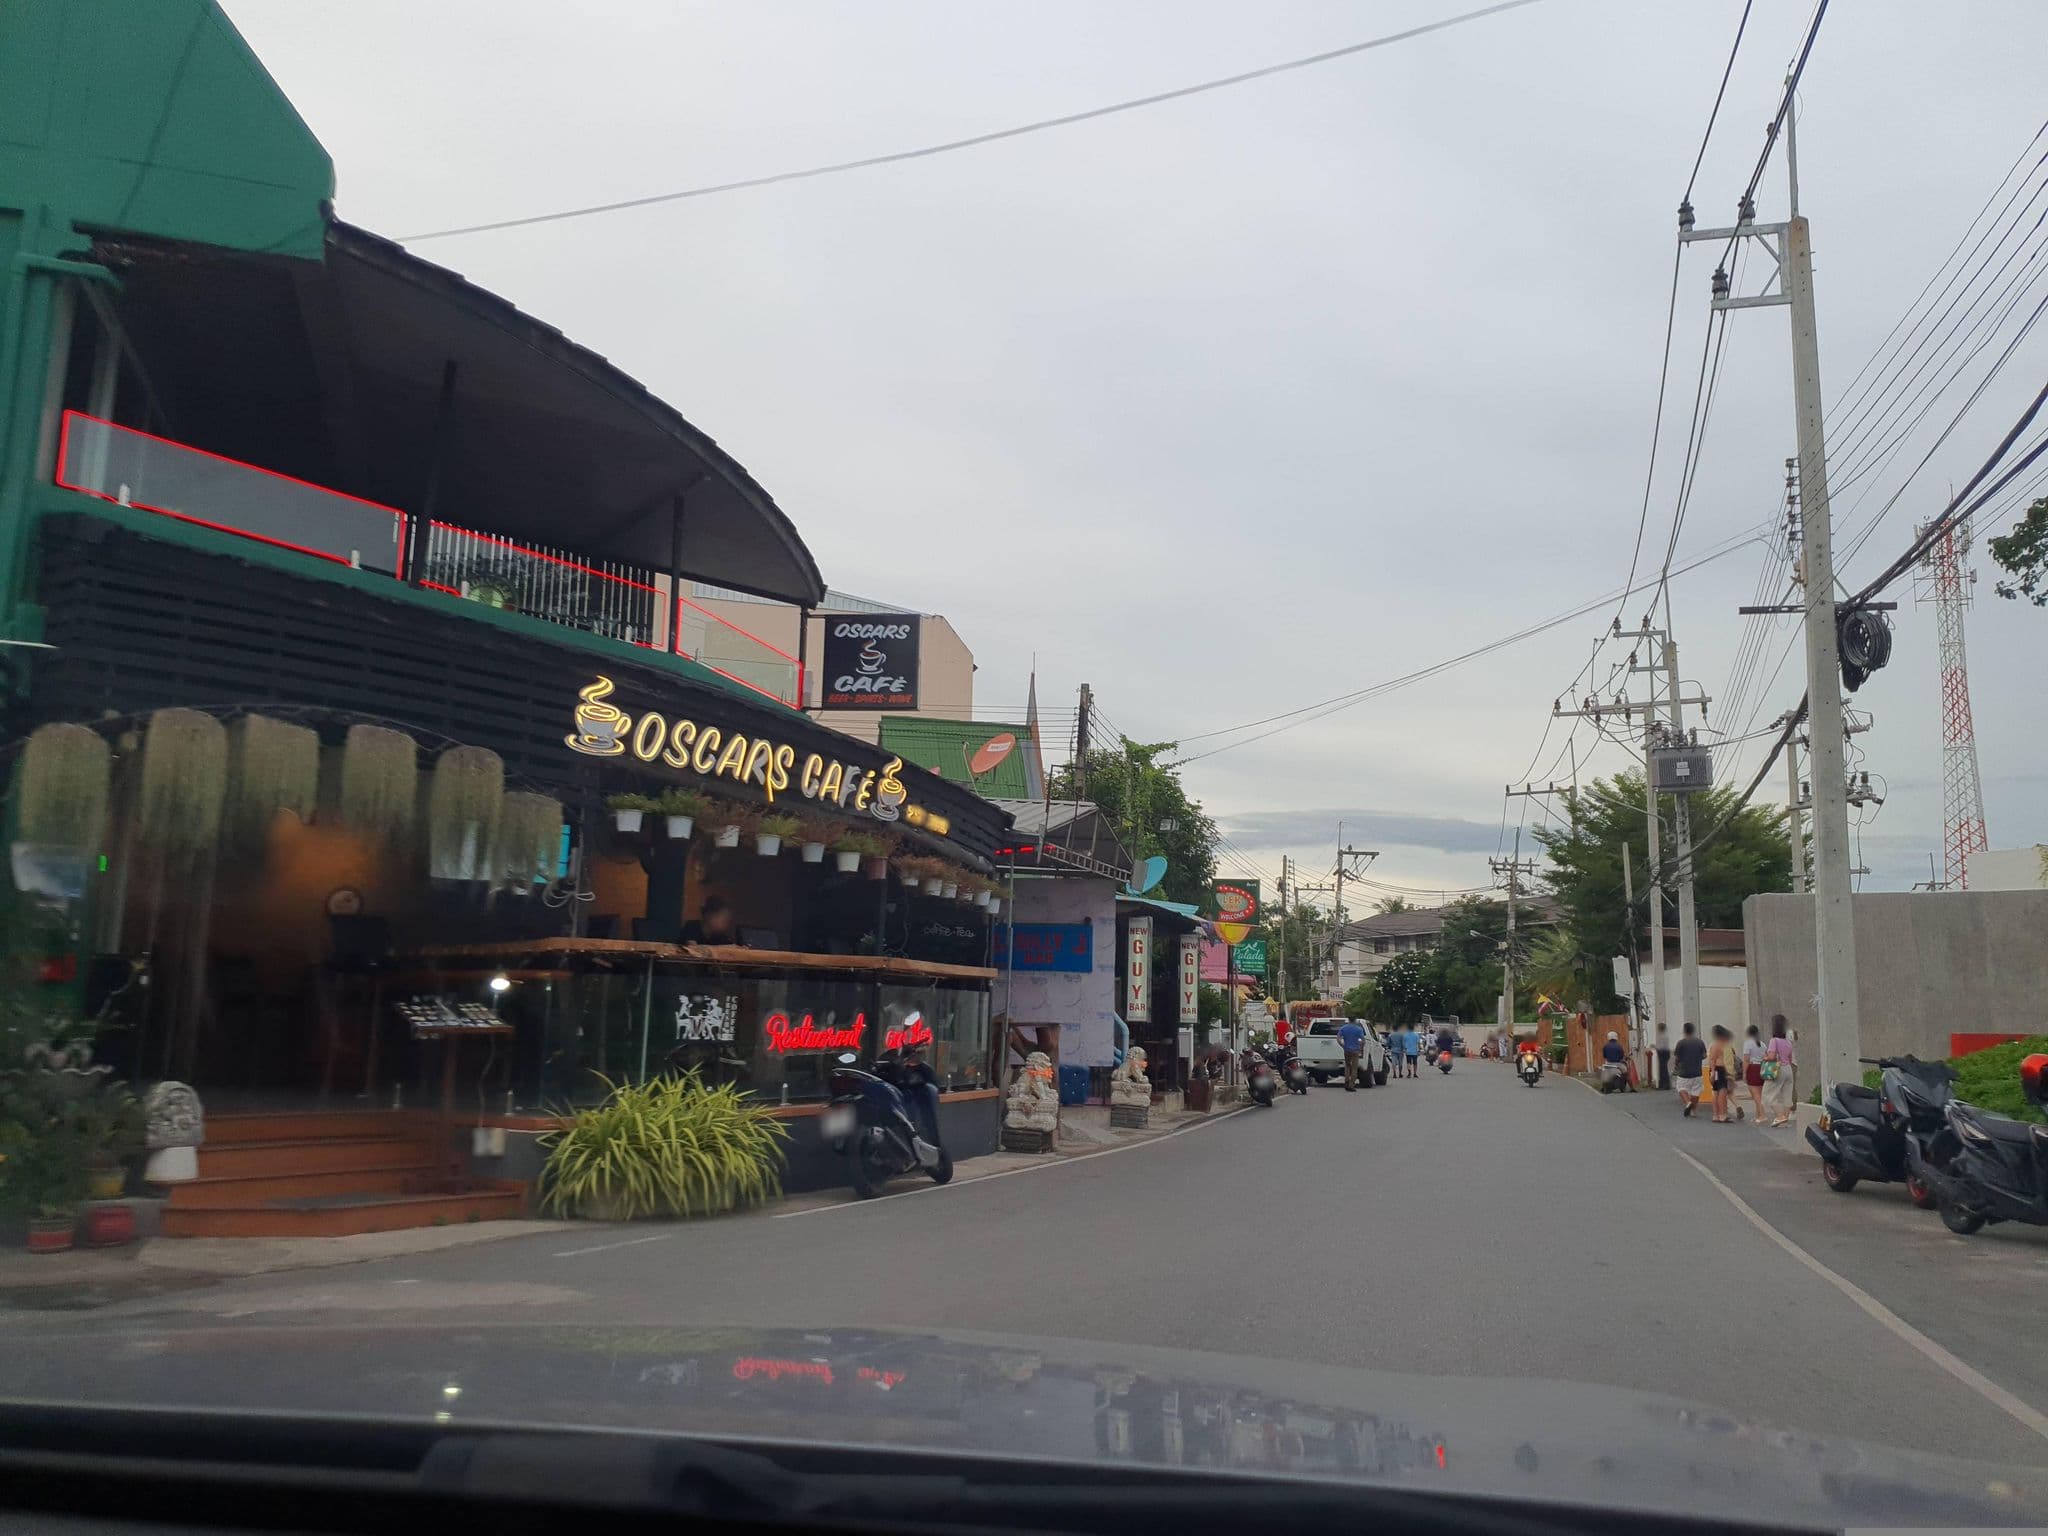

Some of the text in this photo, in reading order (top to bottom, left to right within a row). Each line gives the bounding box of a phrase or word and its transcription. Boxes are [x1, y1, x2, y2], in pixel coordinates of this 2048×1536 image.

[834, 623, 911, 639] OSCARS
[633, 711, 795, 799] OSCARS
[1129, 927, 1147, 935] NEW
[1181, 942, 1197, 950] NEW
[1132, 939, 1144, 1000] GUY
[1184, 953, 1194, 1005] GUY
[1128, 1003, 1146, 1012] BAR
[1181, 1007, 1197, 1015] BAR
